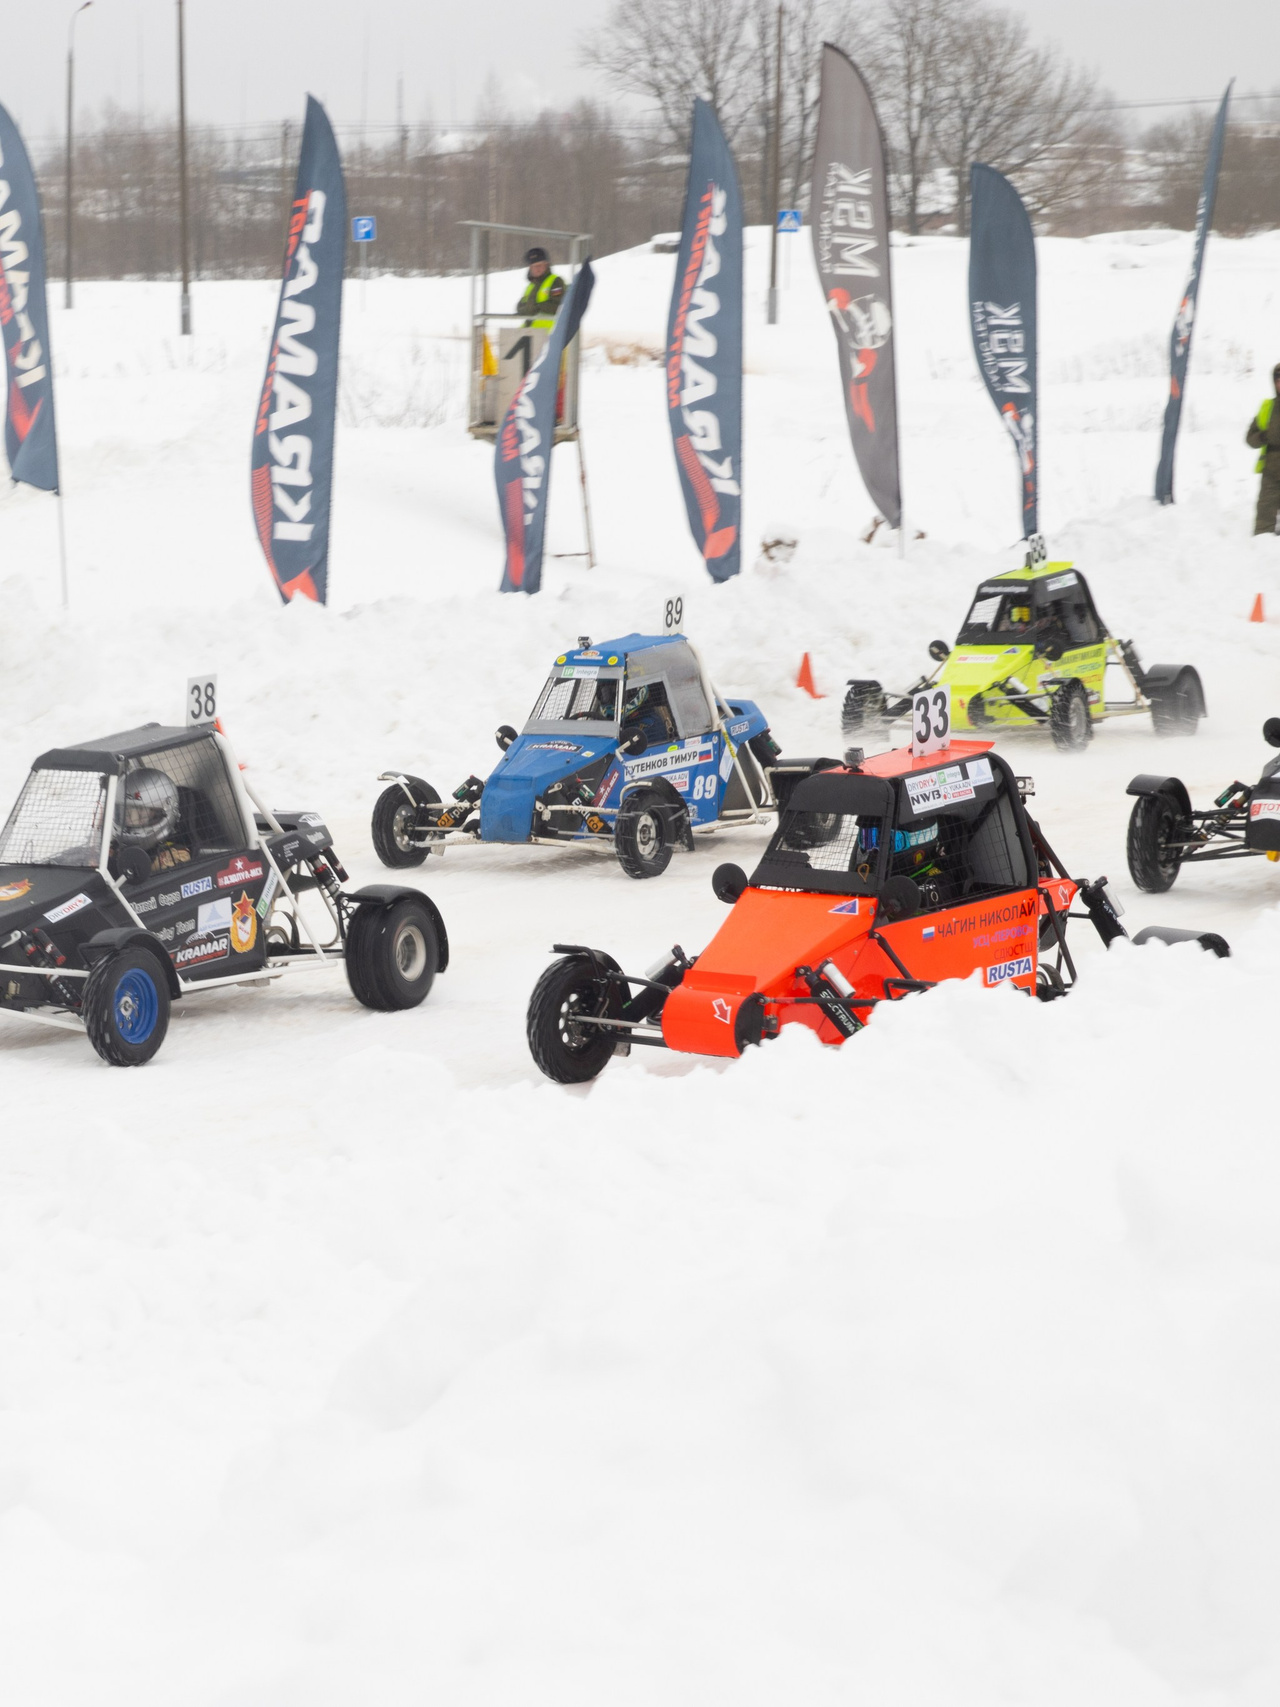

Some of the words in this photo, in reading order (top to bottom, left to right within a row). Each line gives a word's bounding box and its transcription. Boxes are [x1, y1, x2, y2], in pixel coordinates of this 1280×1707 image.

[357, 218, 373, 240] P
[503, 335, 532, 378] 1
[665, 596, 683, 629] 89
[189, 681, 216, 722] 38
[731, 721, 749, 736] RUSTA
[915, 690, 949, 744] 33
[670, 750, 698, 766] ТИМУР
[693, 774, 718, 801] 89
[910, 789, 942, 807] NWB
[949, 782, 962, 792] YUKA
[182, 877, 211, 898] RUSTA
[937, 915, 976, 938] ЧАГИН
[979, 898, 1036, 928] НИКОЛАЙ
[176, 937, 228, 963] KRAMAR
[973, 934, 990, 949] УСЦ
[994, 942, 1033, 961] СДЮСТШ
[988, 957, 1033, 984] RUSTA
